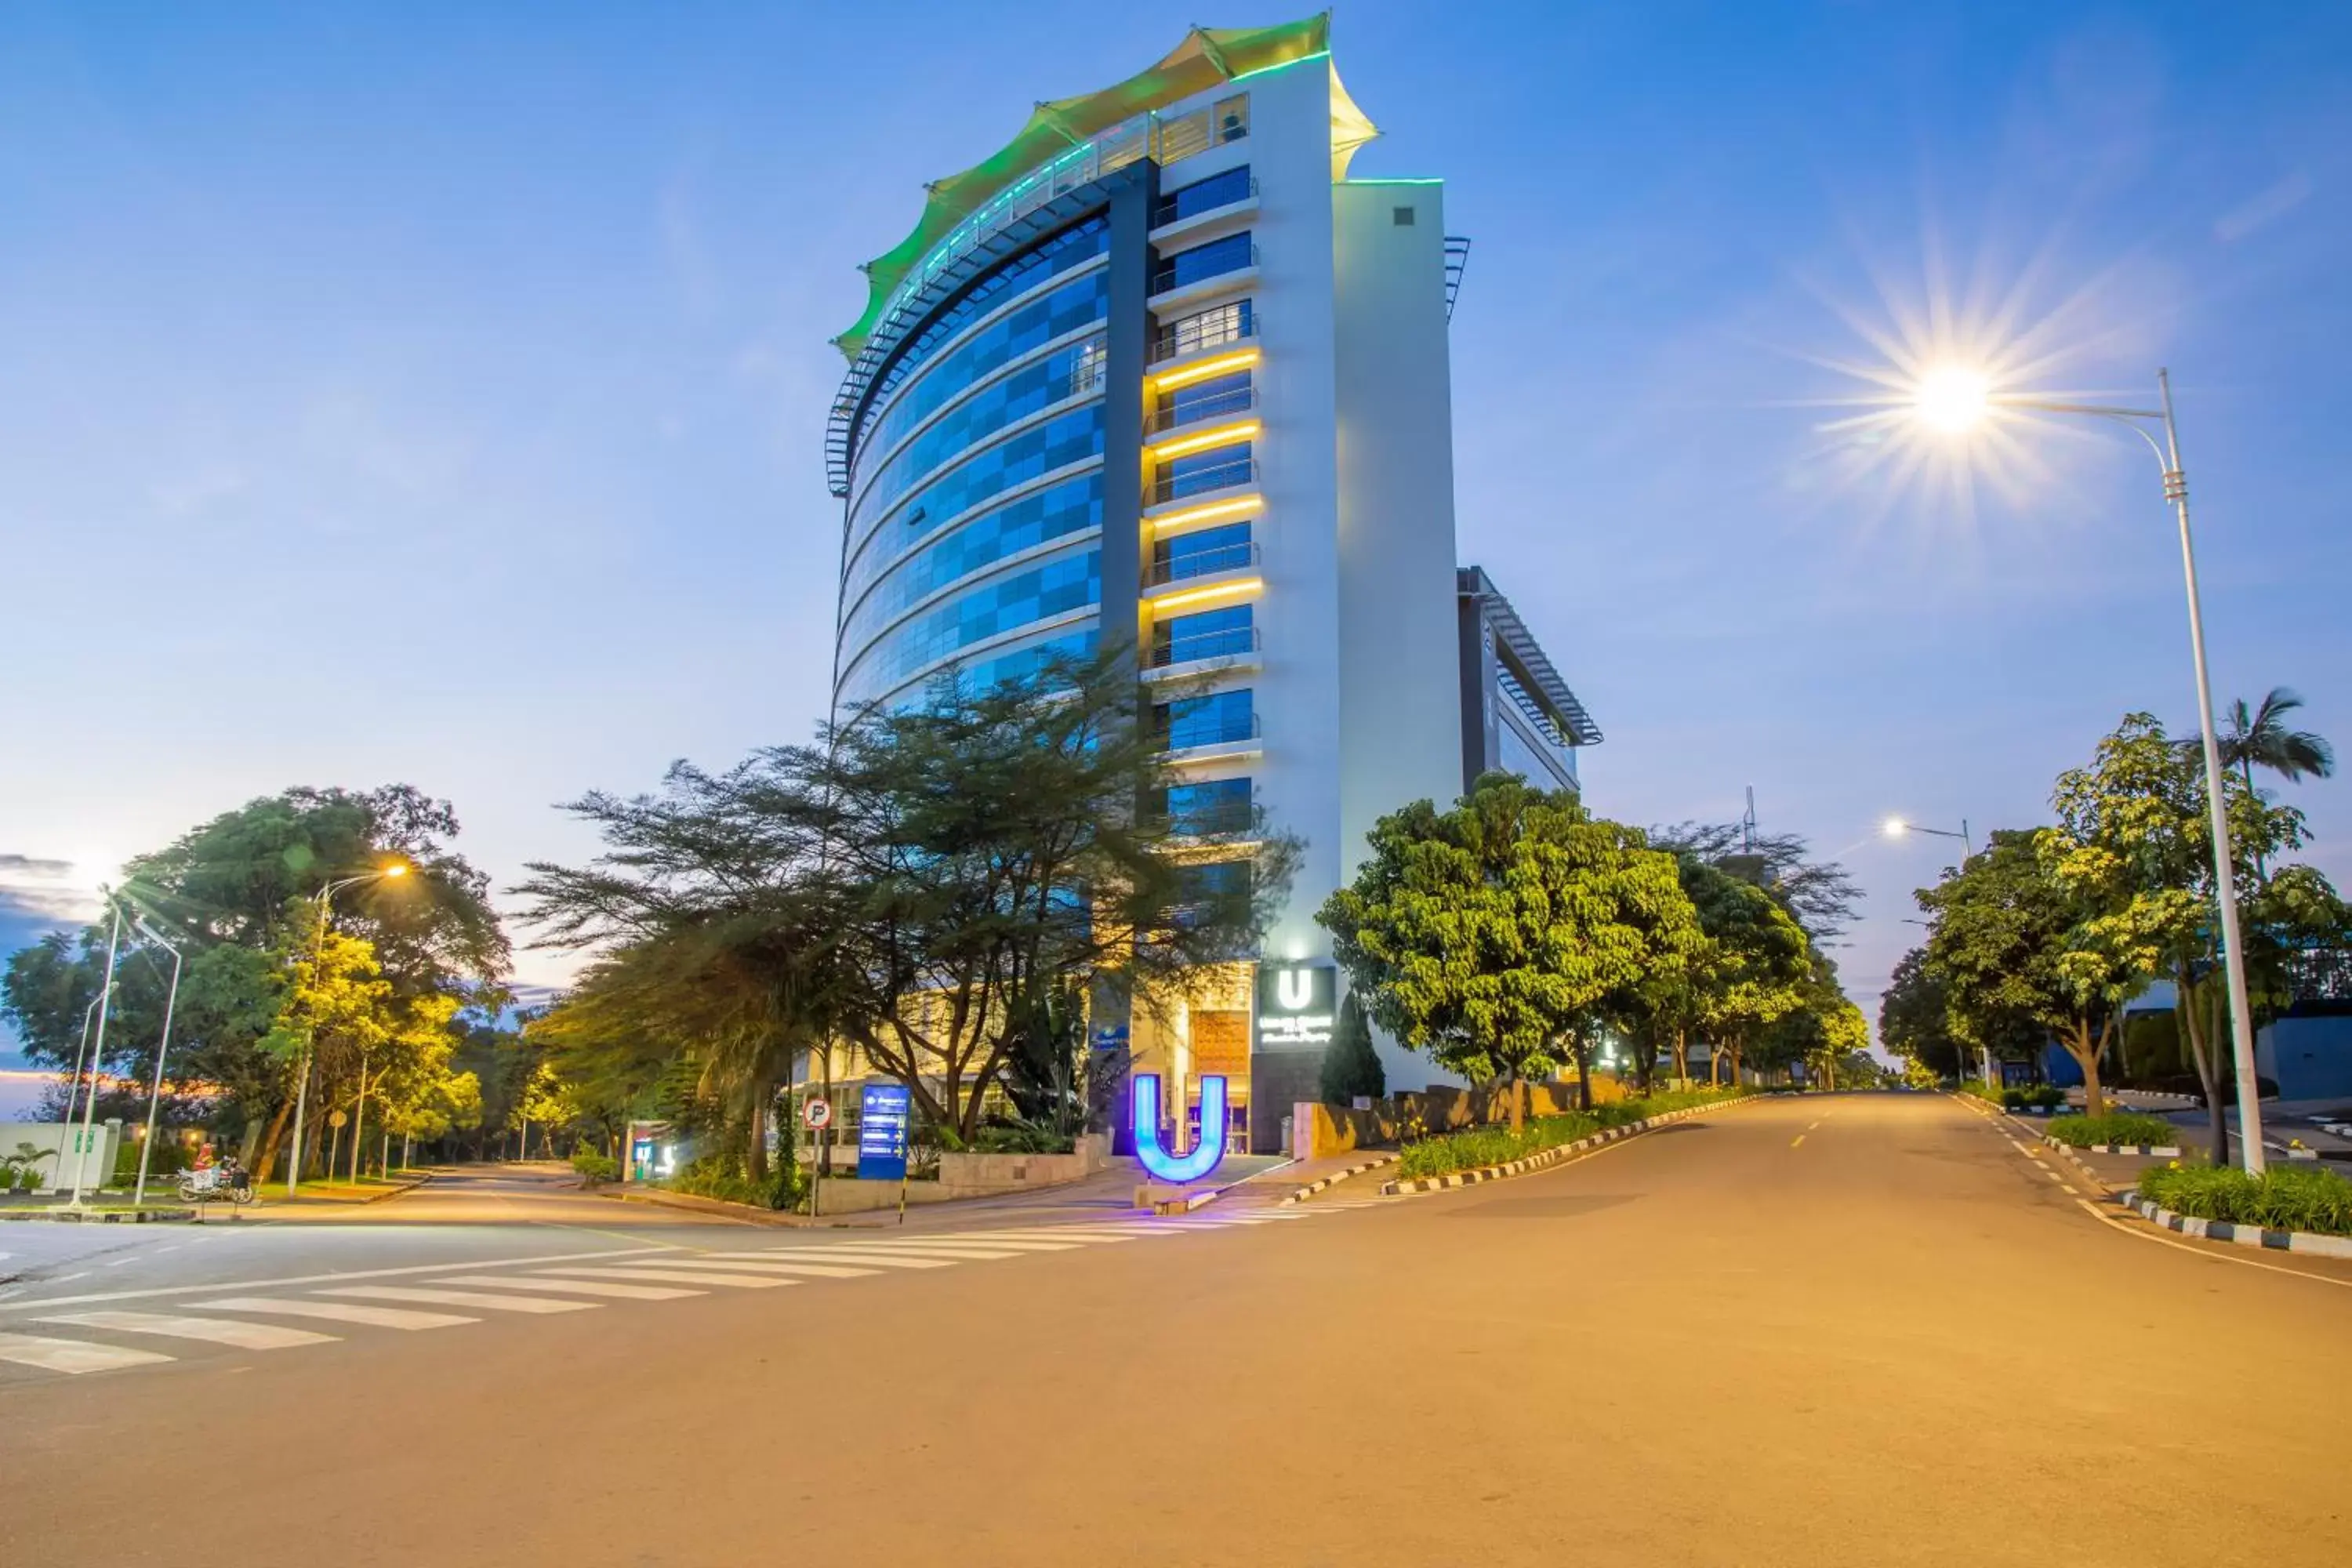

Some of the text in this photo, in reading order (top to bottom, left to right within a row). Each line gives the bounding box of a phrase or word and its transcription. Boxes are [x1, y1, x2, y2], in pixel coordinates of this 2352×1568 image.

[1278, 969, 1312, 1010] U
[811, 1105, 825, 1121] P
[1134, 1074, 1227, 1183] U
